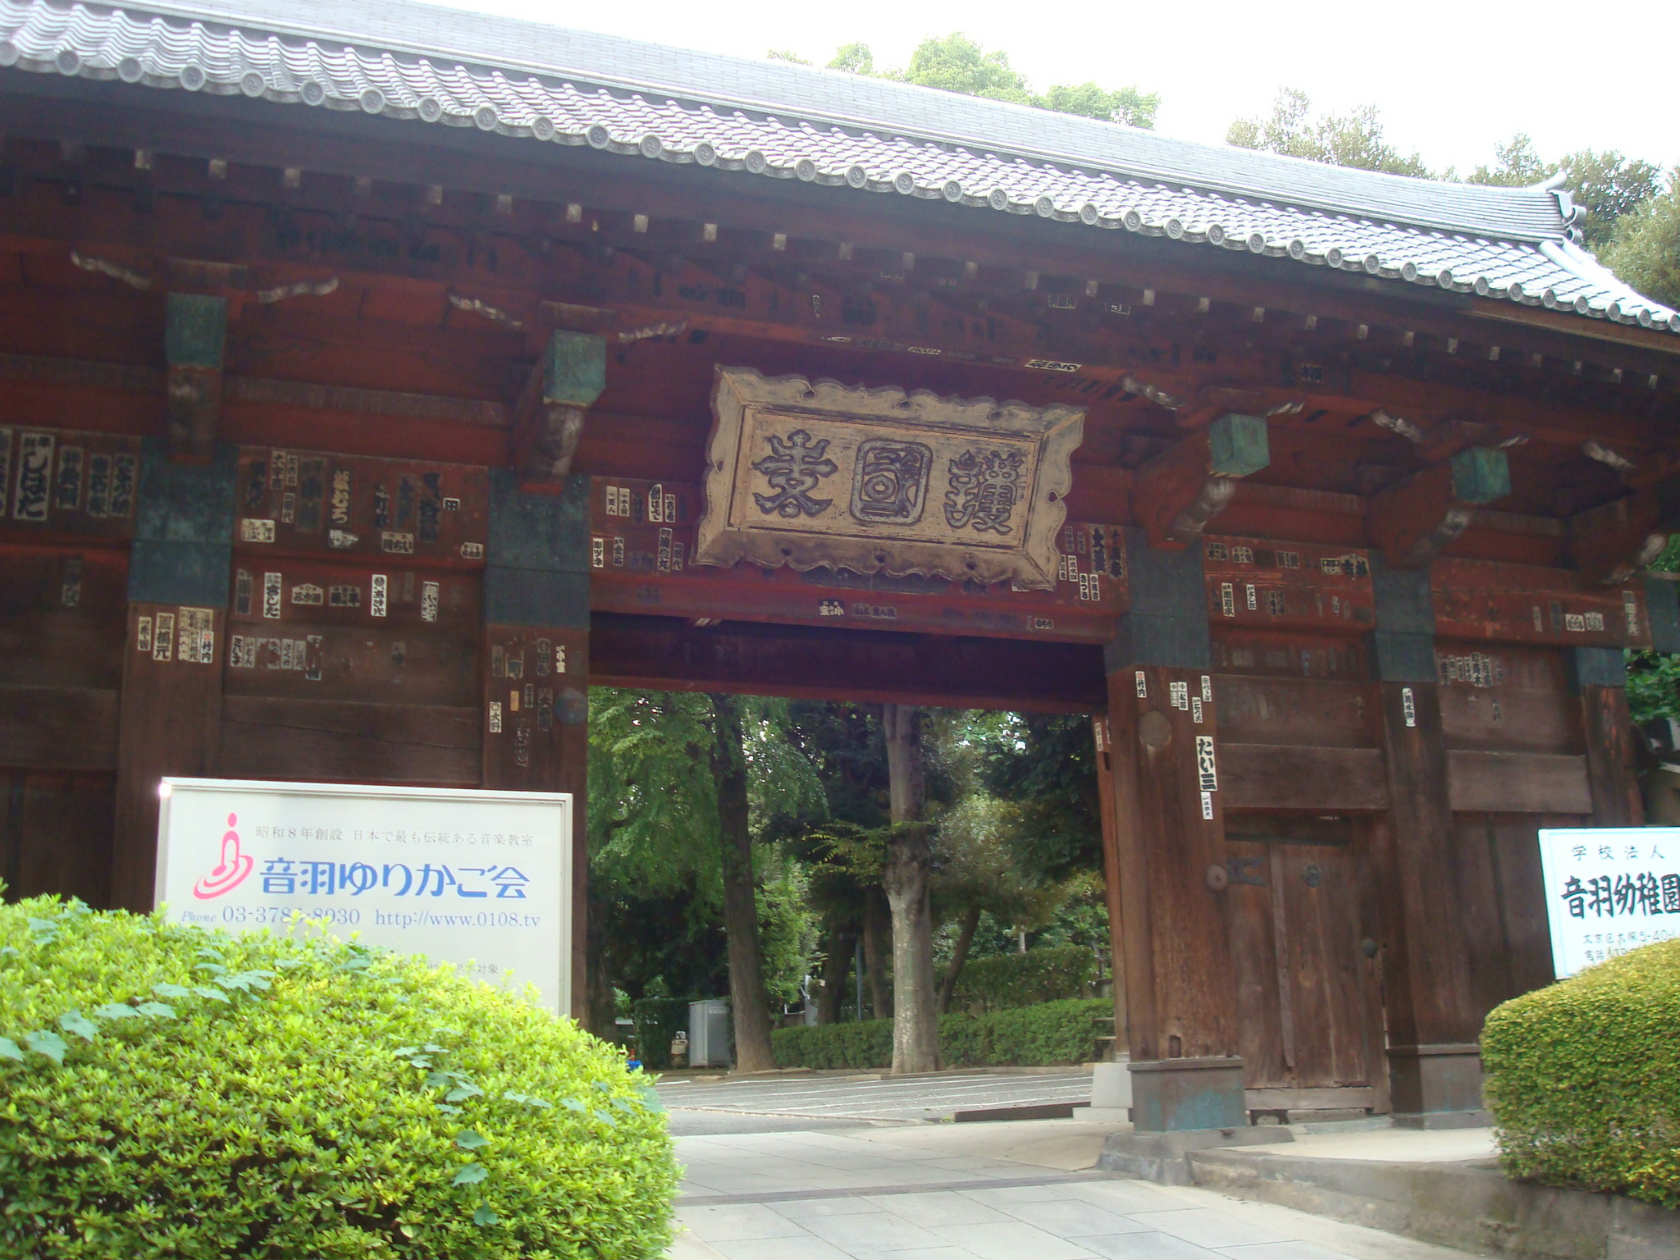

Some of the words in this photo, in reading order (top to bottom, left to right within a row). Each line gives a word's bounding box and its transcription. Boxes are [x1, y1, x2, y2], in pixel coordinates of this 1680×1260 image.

[260, 856, 531, 899] 音羽ゆりかご会
[1561, 871, 1680, 919] 音羽幼稚園
[375, 909, 541, 929] http://www.0108.tv
